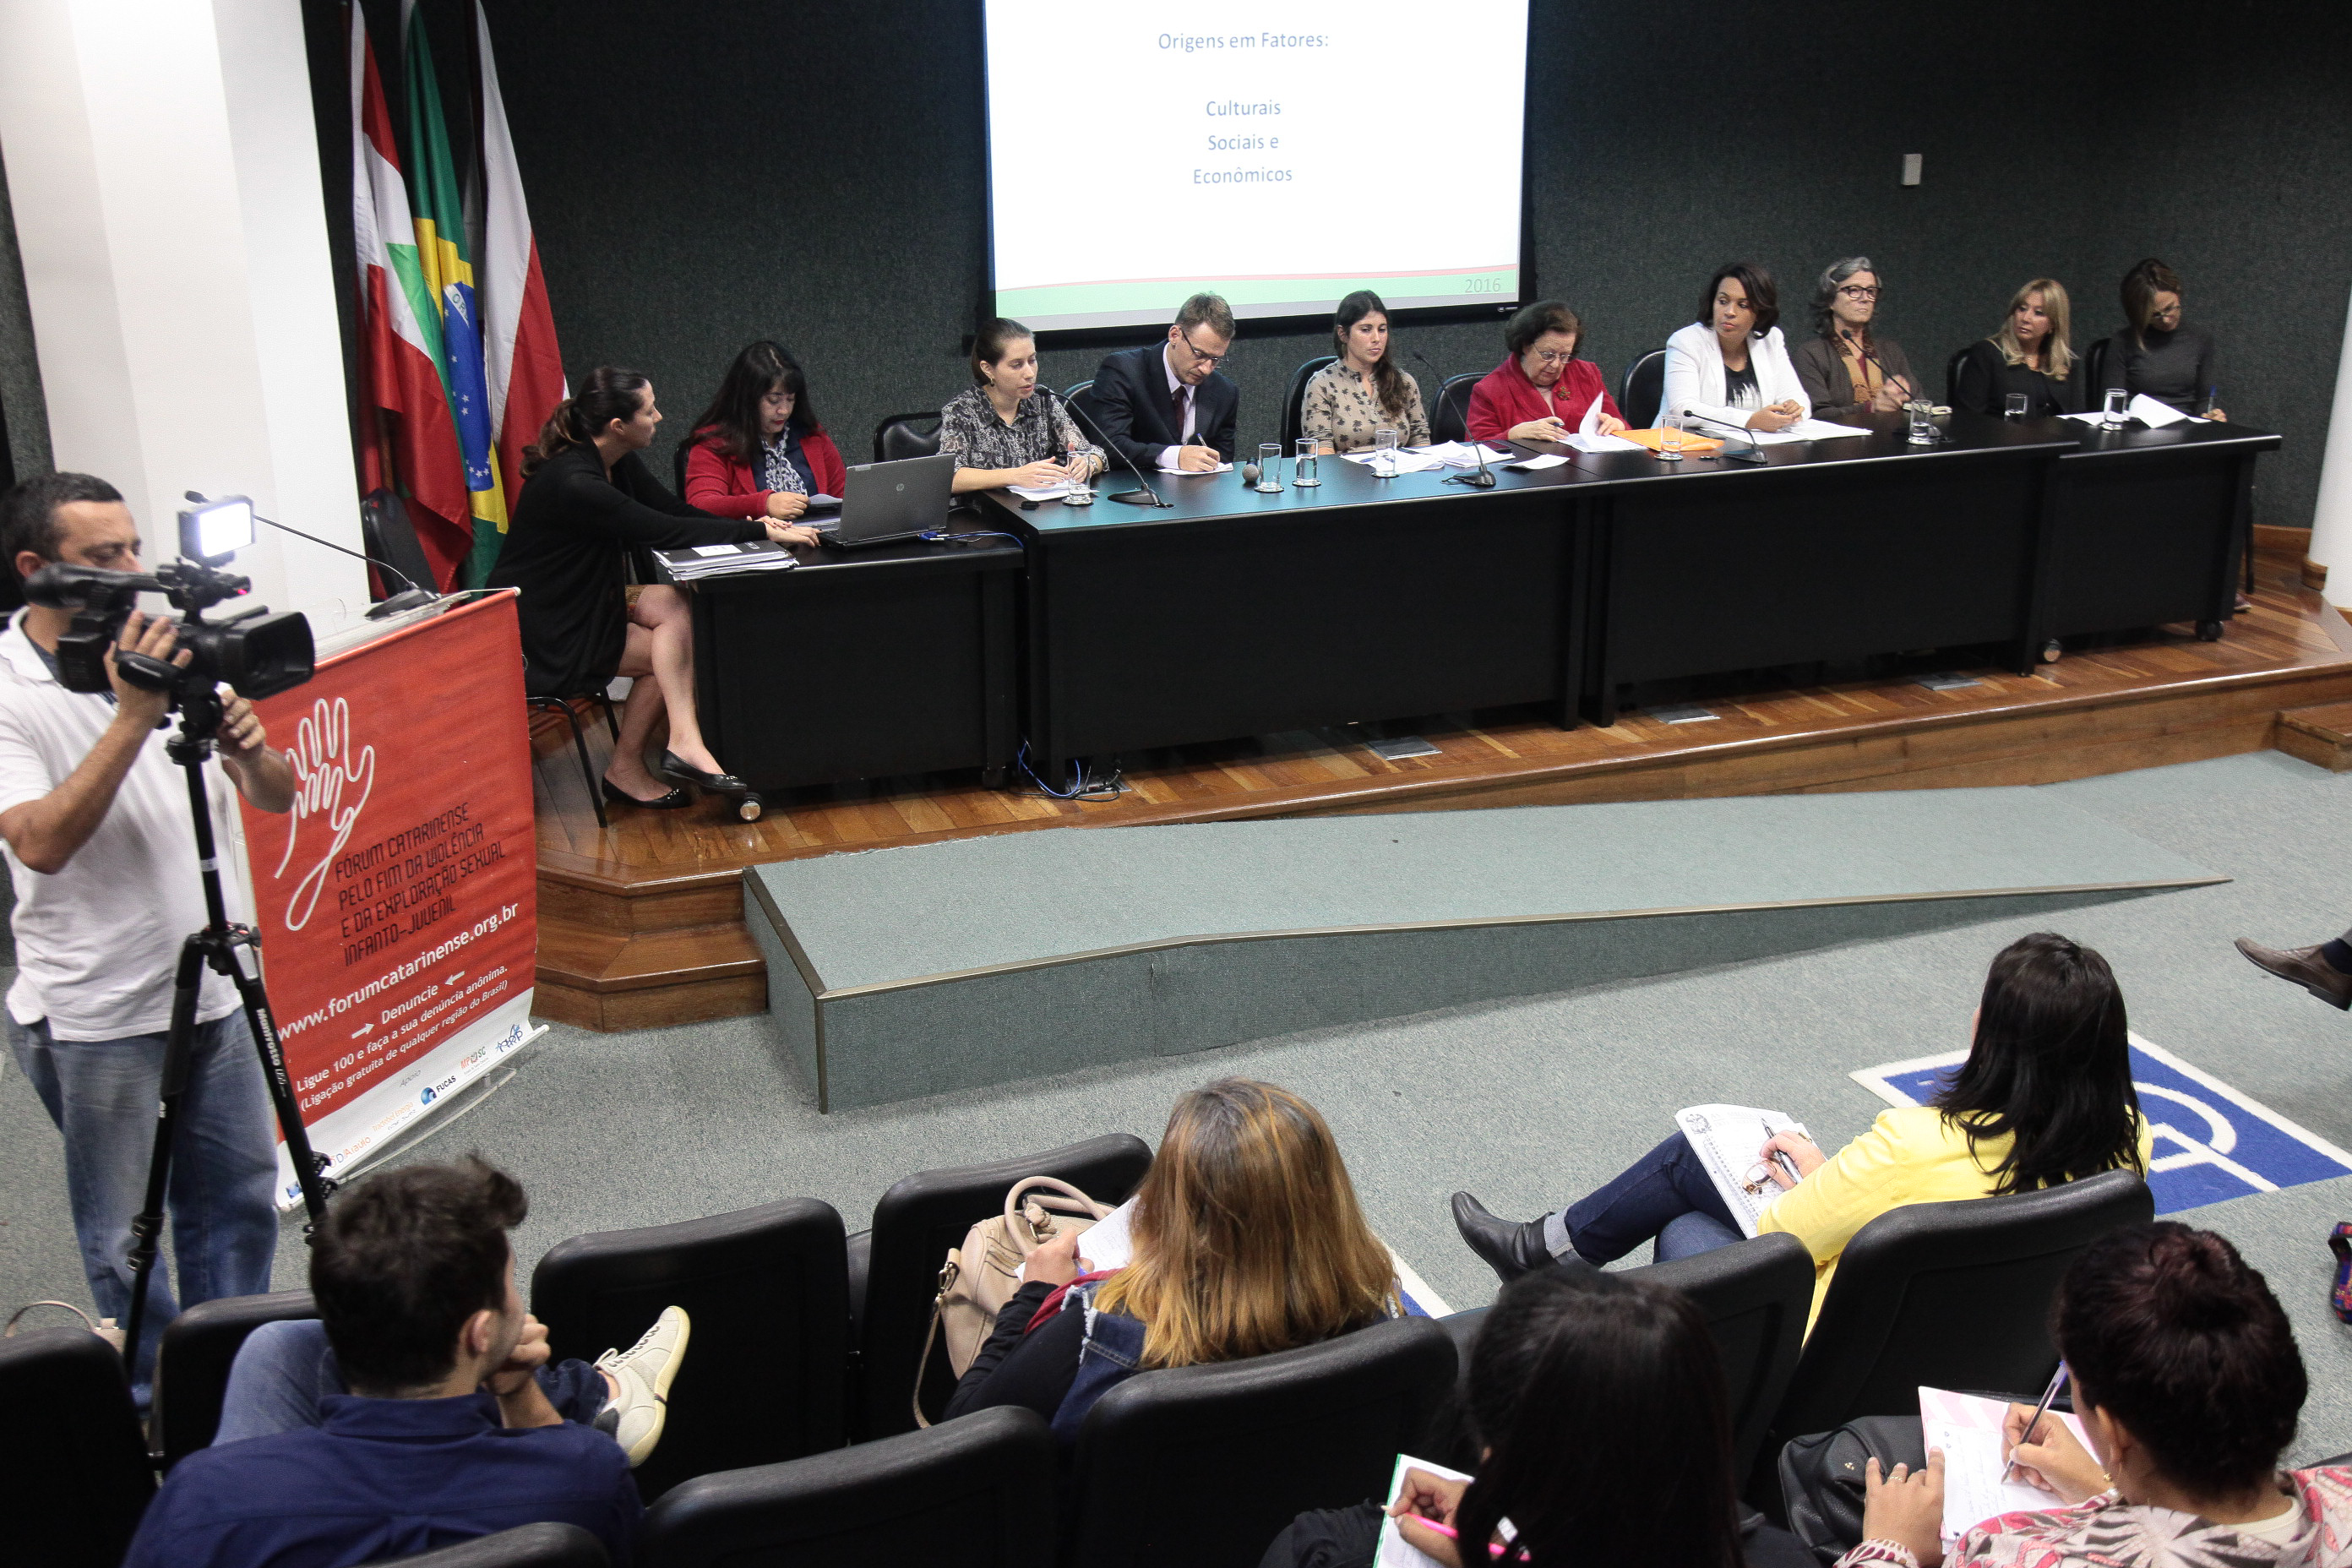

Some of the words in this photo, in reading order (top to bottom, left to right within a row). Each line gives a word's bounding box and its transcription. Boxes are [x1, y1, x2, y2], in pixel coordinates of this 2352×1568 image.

[1158, 33, 1224, 52] Origens
[1229, 35, 1255, 48] em
[1261, 32, 1329, 47] Fatores:
[1206, 99, 1281, 116] Culturais
[1207, 133, 1265, 150] Sociais
[1269, 137, 1279, 149] e
[1194, 166, 1293, 184] Econômicos
[1465, 278, 1500, 293] 2016
[335, 843, 384, 882] FÓRUM
[387, 803, 470, 858] CATARINENSE
[339, 878, 373, 911] PELO
[376, 864, 402, 892] FIM
[405, 854, 423, 879] DA
[425, 823, 484, 868] VIOLÊNCIA
[341, 918, 351, 938] E
[354, 908, 373, 933] DA
[375, 864, 457, 921] EXPLORAÇÃO
[459, 841, 506, 878] SEXUAL
[276, 903, 518, 1042] www.forumcatarinense.org.br
[381, 985, 438, 1025] Denuncie
[297, 1069, 329, 1092] Ligue
[333, 1054, 355, 1072] 100
[357, 1049, 365, 1059] e
[367, 1035, 389, 1054] faça
[391, 1030, 398, 1040] a
[400, 1018, 418, 1035] sua
[421, 990, 464, 1022] denúncia
[466, 966, 508, 994] anônima.
[300, 1081, 344, 1112] (Ligação
[346, 1058, 384, 1087] gratuita
[386, 1048, 397, 1061] de
[400, 1022, 440, 1054] qualquer
[442, 1006, 467, 1027] região
[469, 997, 480, 1009] do
[482, 980, 508, 1002] Brasil)
[436, 1075, 456, 1092] FUCAS
